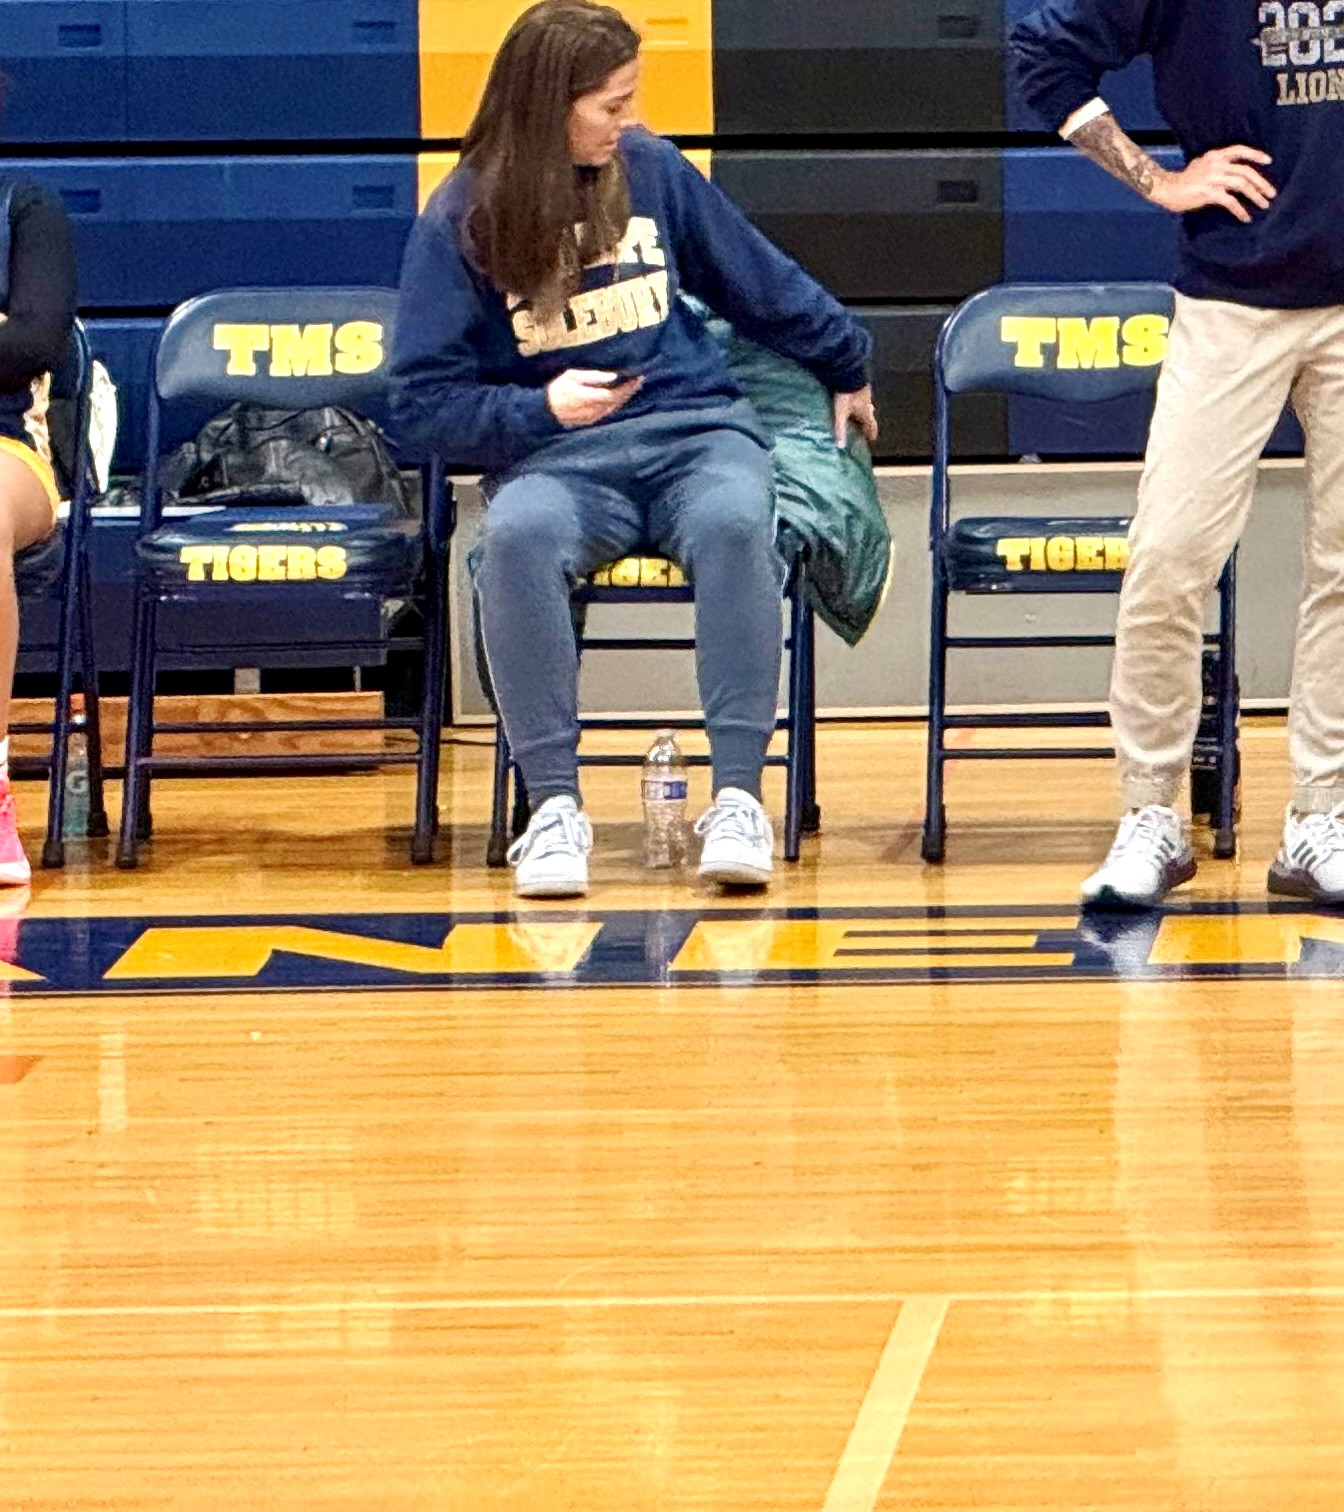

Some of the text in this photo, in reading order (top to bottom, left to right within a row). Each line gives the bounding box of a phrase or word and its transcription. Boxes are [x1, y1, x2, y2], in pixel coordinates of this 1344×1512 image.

[212, 320, 384, 377] TMS
[1001, 314, 1170, 369] TMS
[180, 544, 348, 582] TIGERS
[996, 536, 1133, 572] TIGER
